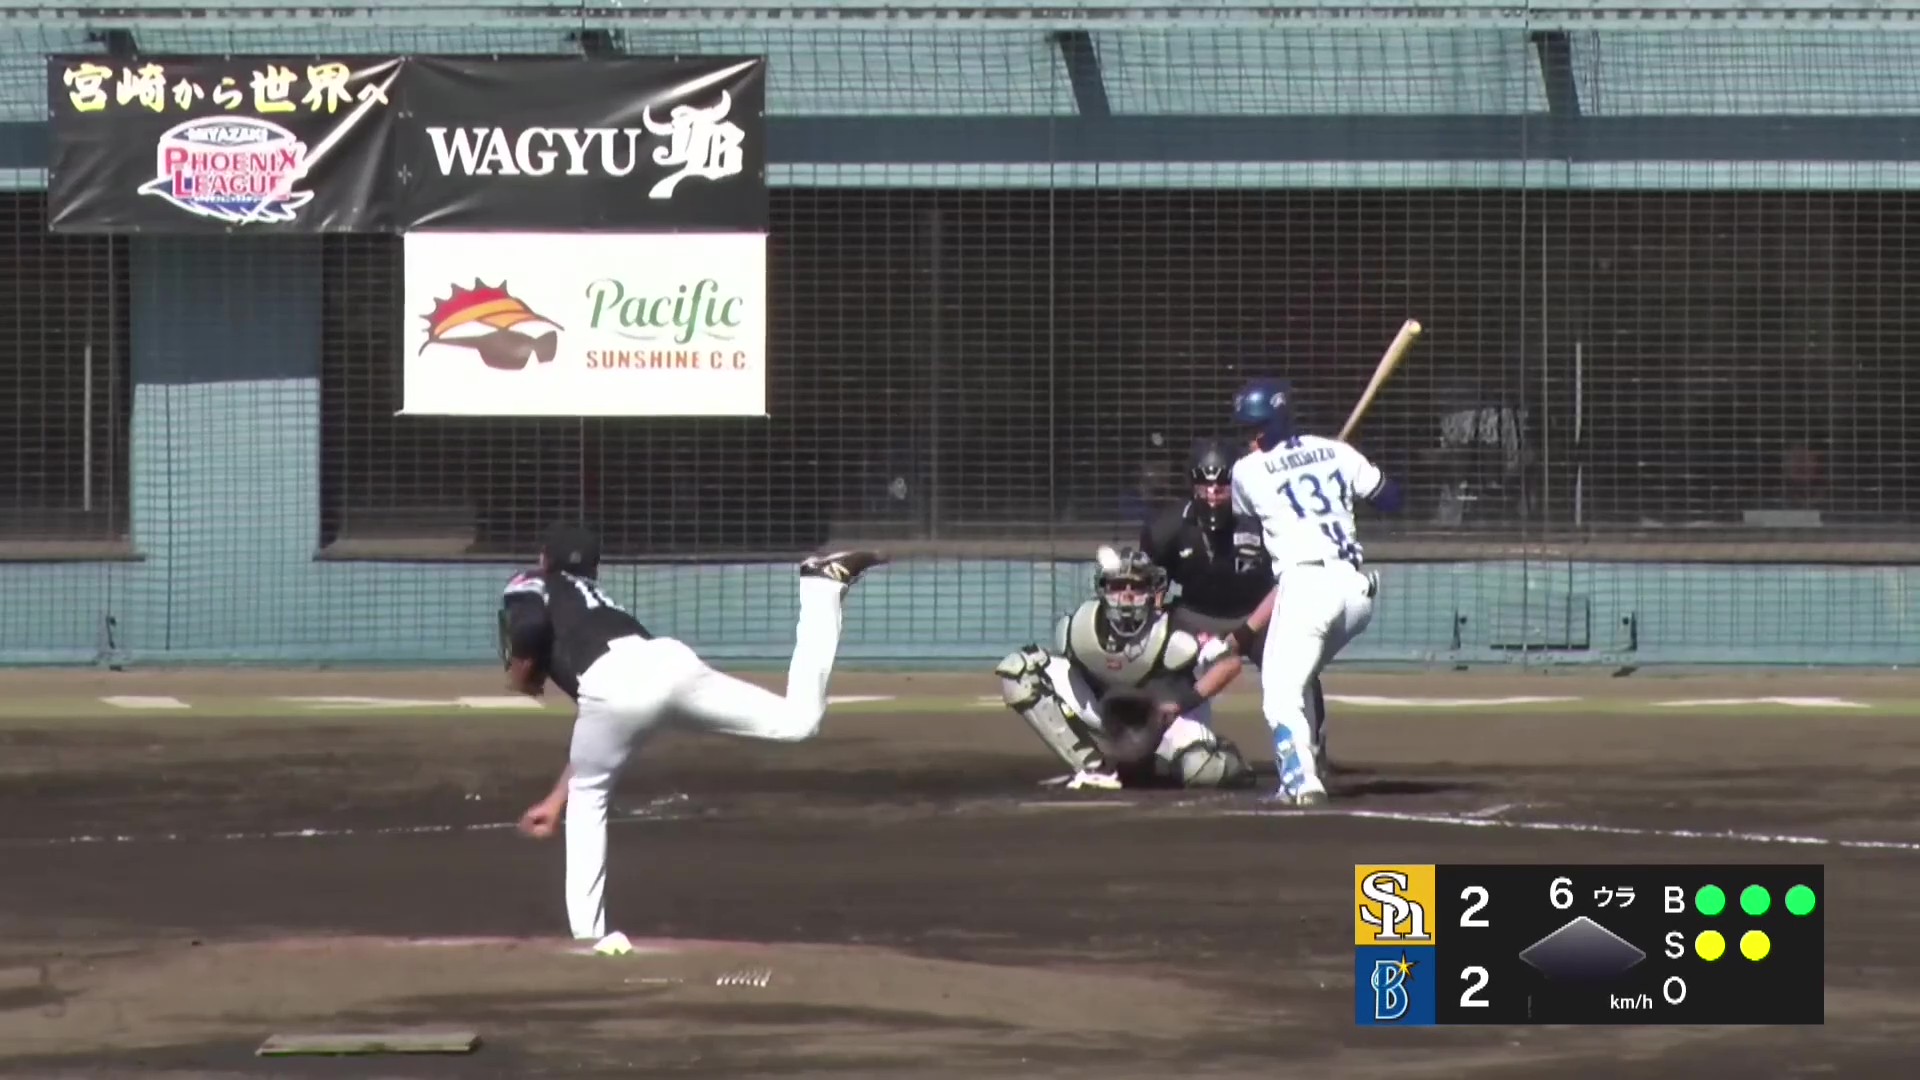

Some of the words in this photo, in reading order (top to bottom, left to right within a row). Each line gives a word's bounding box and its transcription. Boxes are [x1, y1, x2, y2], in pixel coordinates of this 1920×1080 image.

[64, 62, 388, 113] 宮崎から世界へ
[165, 147, 297, 174] PHOENIX
[426, 127, 641, 176] WAGYU
[586, 278, 743, 344] Pacific
[586, 350, 700, 370] SUNSHINE
[1276, 468, 1350, 519] 131
